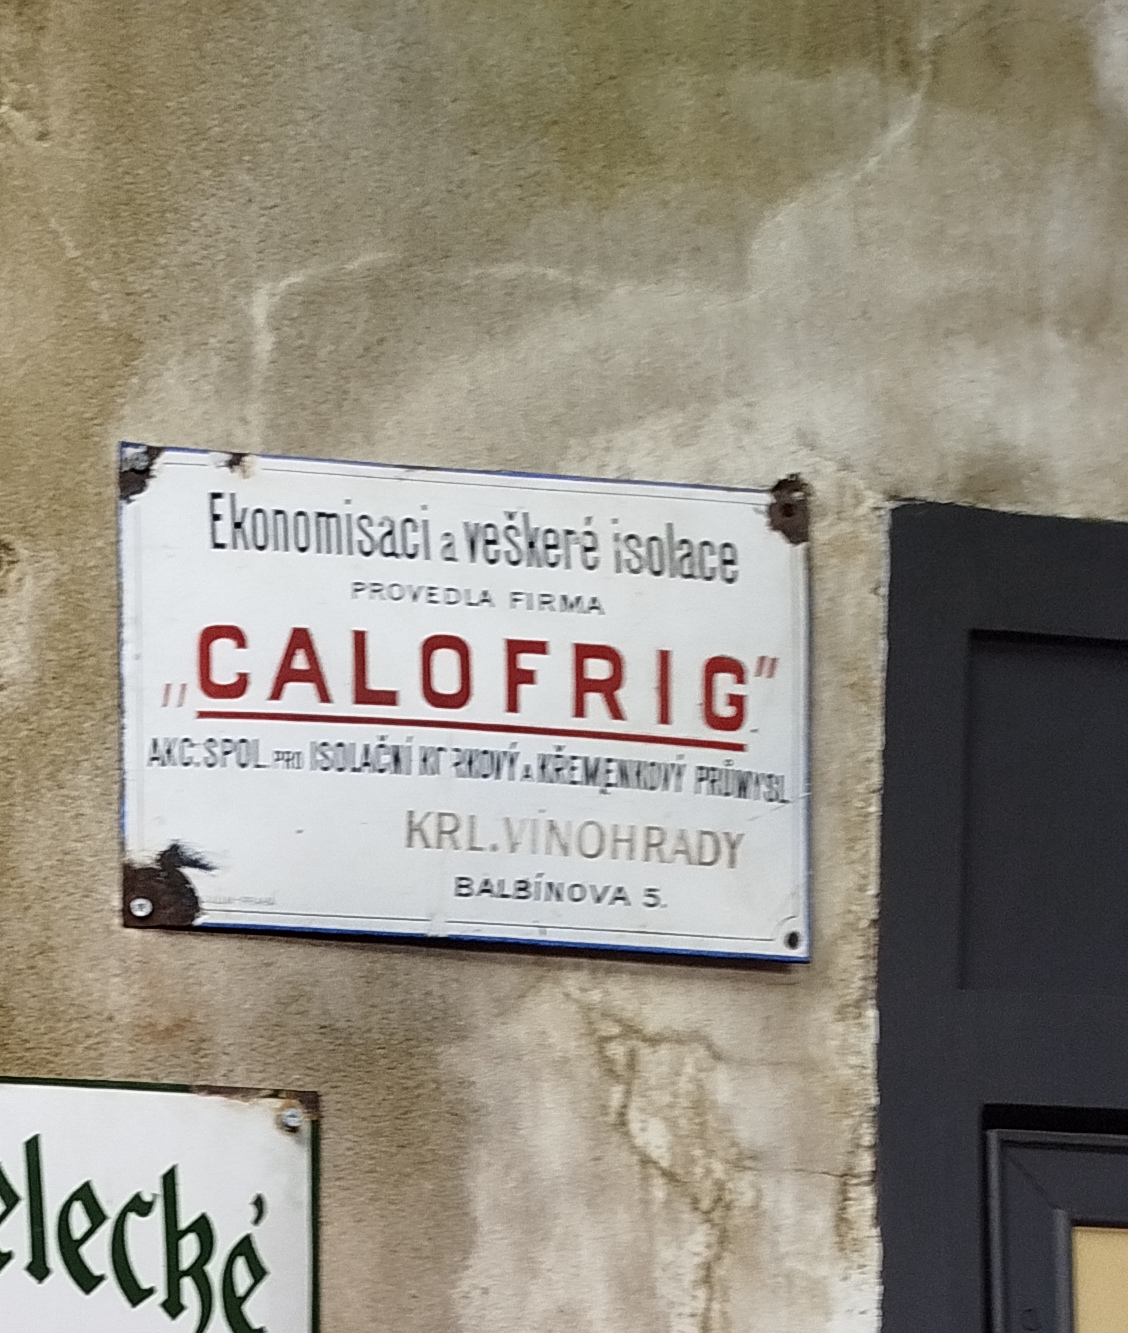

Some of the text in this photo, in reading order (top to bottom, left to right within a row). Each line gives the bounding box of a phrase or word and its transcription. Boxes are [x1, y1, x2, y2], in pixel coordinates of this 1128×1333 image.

[209, 491, 739, 584] Ekonomisaci a veškeré isolace
[352, 582, 606, 615] PROVEDLA FIRMA
[309, 735, 413, 775] ISOLAČNÍ
[454, 872, 631, 907] BALBÍNOVA
